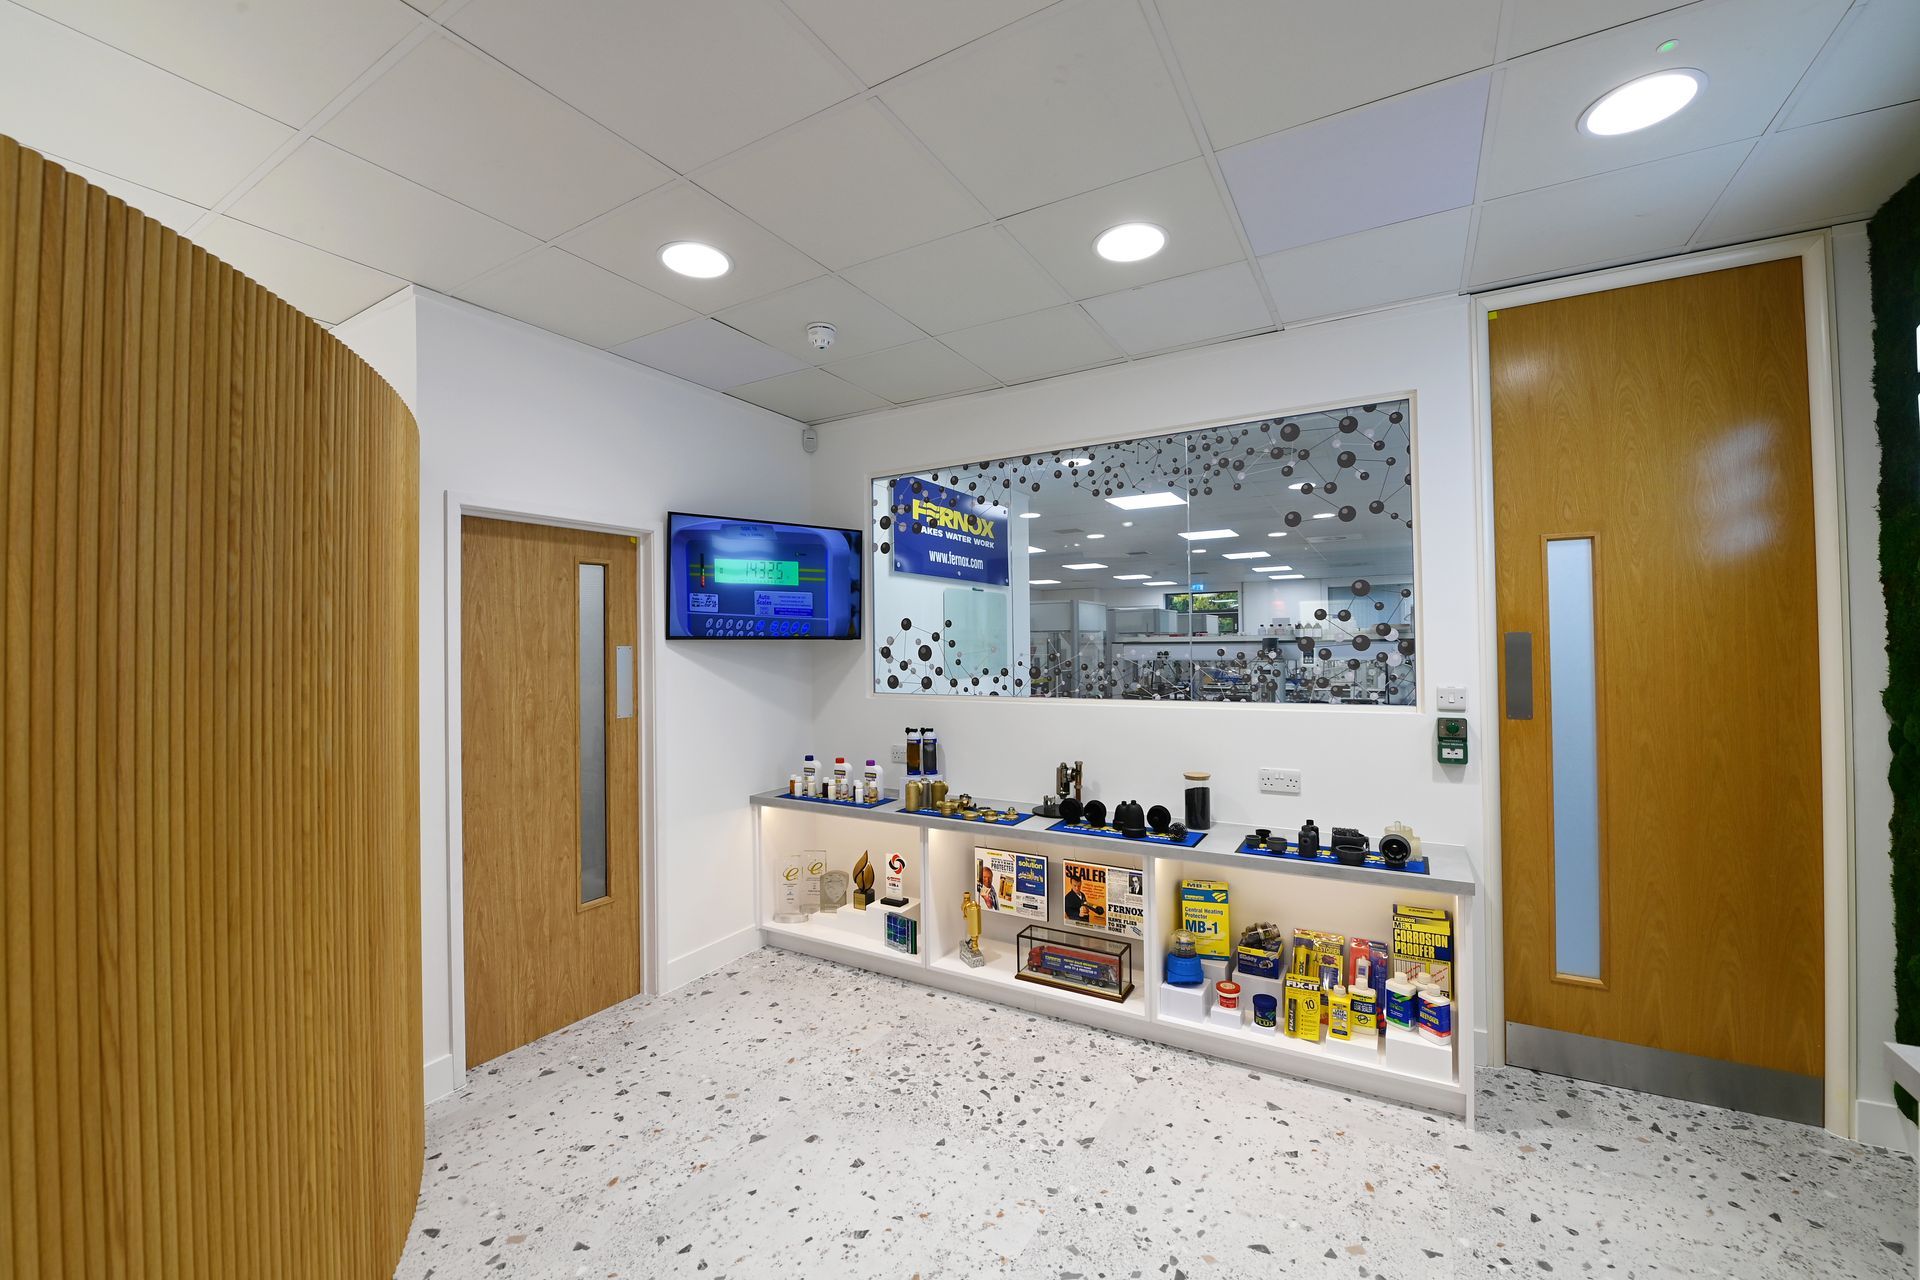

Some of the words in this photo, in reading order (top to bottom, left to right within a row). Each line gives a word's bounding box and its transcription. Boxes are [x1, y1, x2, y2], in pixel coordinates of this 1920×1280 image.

[912, 499, 995, 539] FERNOX
[920, 526, 943, 537] AKES
[945, 531, 972, 544] WATER
[974, 538, 995, 549] WORK
[929, 550, 984, 570] www.fernox.com
[1018, 860, 1043, 870] solution
[1065, 864, 1106, 883] SEALER
[1108, 904, 1144, 917] FERNOX
[1204, 908, 1224, 916] Heating
[1185, 919, 1218, 934] MB-1
[1394, 929, 1448, 948] CORROSION
[1394, 941, 1435, 959] PROOFER
[1286, 980, 1320, 991] FIX-IT
